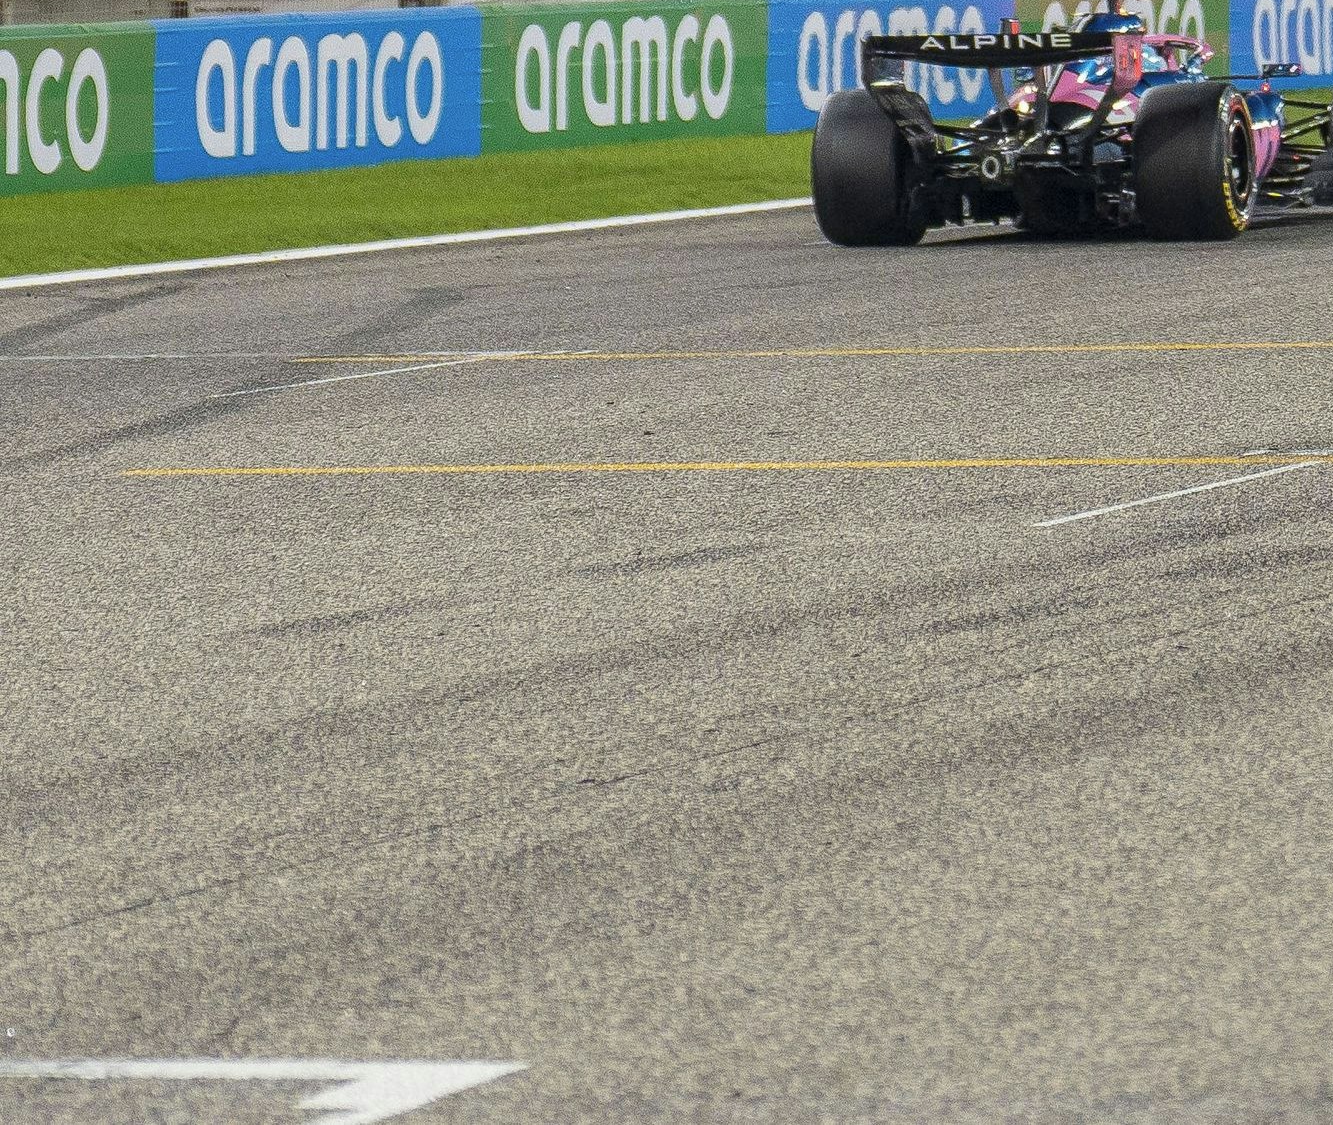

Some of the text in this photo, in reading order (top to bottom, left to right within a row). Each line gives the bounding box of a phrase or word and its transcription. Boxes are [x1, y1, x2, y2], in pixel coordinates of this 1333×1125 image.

[196, 30, 443, 158] aramco
[515, 13, 734, 134] aramco
[919, 33, 1072, 51] ALPINE
